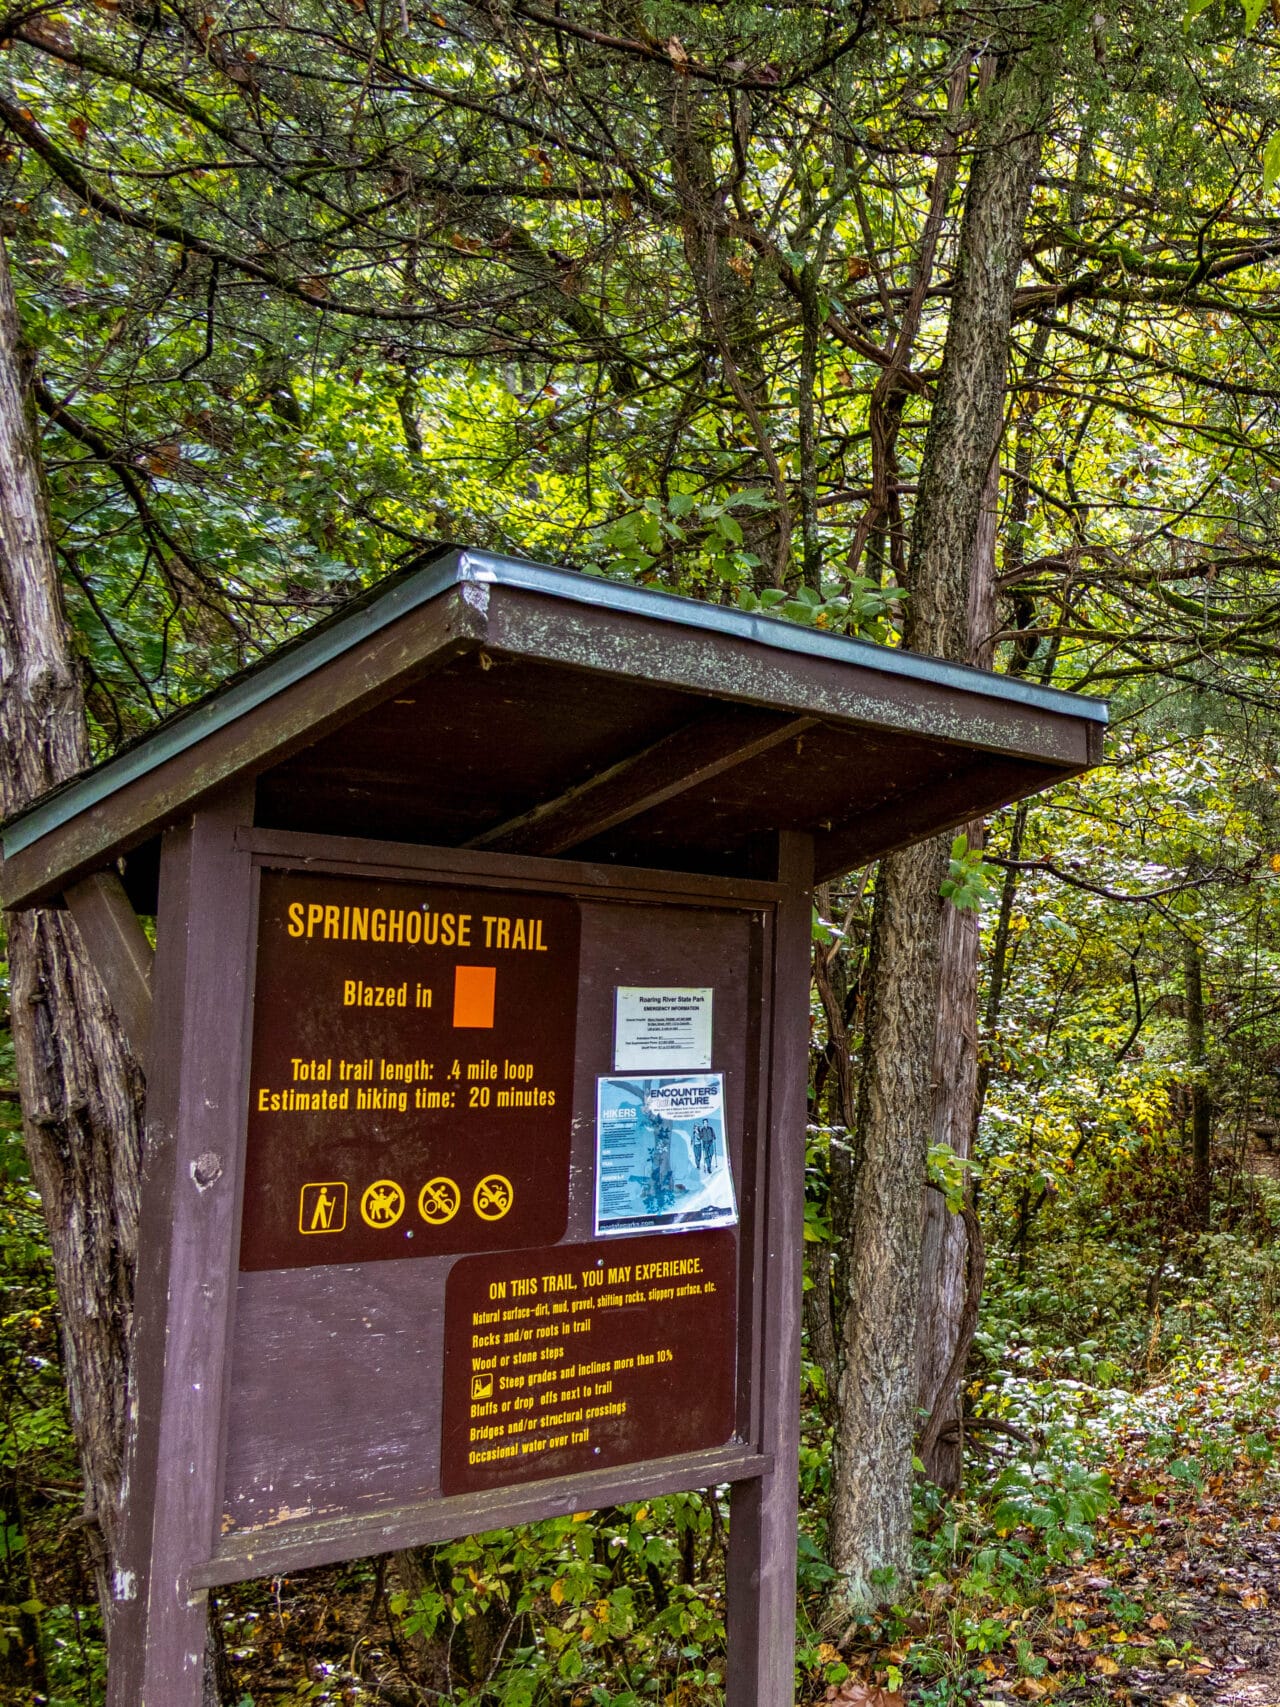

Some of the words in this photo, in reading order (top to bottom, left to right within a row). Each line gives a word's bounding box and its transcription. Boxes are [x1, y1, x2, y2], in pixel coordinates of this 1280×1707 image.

[288, 902, 472, 946] SPRINGHOUSE
[482, 916, 548, 950] TRAIL
[344, 980, 408, 1006] Blazed
[416, 982, 432, 1008] in
[290, 1058, 332, 1080] Total
[340, 1058, 374, 1080] trail
[380, 1058, 434, 1084] length:
[448, 1060, 460, 1080] .4
[468, 1060, 498, 1080] mile
[504, 1060, 534, 1082] loop
[258, 1088, 348, 1112] Estimated
[356, 1088, 408, 1112] hiking
[416, 1088, 456, 1108] time:
[468, 1086, 490, 1108] 20
[496, 1086, 556, 1108] minutes
[650, 1087, 718, 1098] ENCOUNTERS
[670, 1096, 709, 1106] NATURE
[603, 1108, 637, 1119] HIKERS
[490, 1282, 506, 1300] ON
[510, 1278, 538, 1296] THIS
[542, 1274, 578, 1292] TRAIL,
[582, 1270, 604, 1288] YOU
[608, 1266, 632, 1284] MAY
[636, 1258, 704, 1280] EXPERIENCE.
[472, 1310, 500, 1326] Natural
[552, 1300, 568, 1314] mud,
[572, 1296, 594, 1314] gravel,
[596, 1294, 624, 1308] shifting
[624, 1292, 646, 1304] rocks,
[648, 1288, 674, 1302] slippery
[676, 1284, 702, 1296] surface,
[704, 1282, 716, 1292] etc.
[472, 1332, 500, 1348] Rocks
[504, 1328, 534, 1344] and/or
[536, 1324, 560, 1338] roots
[562, 1322, 570, 1334] in
[574, 1318, 590, 1332] trail
[472, 1354, 496, 1372] Wood
[500, 1356, 510, 1366] or
[512, 1352, 538, 1364] stone
[540, 1346, 564, 1360] steps
[498, 1376, 524, 1390] Steep
[528, 1370, 558, 1386] grades
[560, 1364, 576, 1380] and
[578, 1362, 610, 1376] inclines
[614, 1358, 634, 1370] more
[636, 1354, 654, 1366] than
[656, 1350, 672, 1362] 10%
[470, 1402, 498, 1418] Bluffs
[502, 1400, 512, 1412] or
[514, 1396, 534, 1410] drop
[540, 1390, 558, 1406] offs
[560, 1386, 580, 1402] next
[582, 1386, 592, 1398] to
[594, 1380, 612, 1396] trail
[470, 1426, 504, 1442] Bridges
[508, 1418, 538, 1434] and/or
[540, 1408, 582, 1428] structural
[586, 1402, 626, 1420] crossings
[468, 1442, 518, 1464] Occasional
[522, 1440, 548, 1454] water
[548, 1434, 568, 1448] over
[572, 1428, 590, 1444] trail
